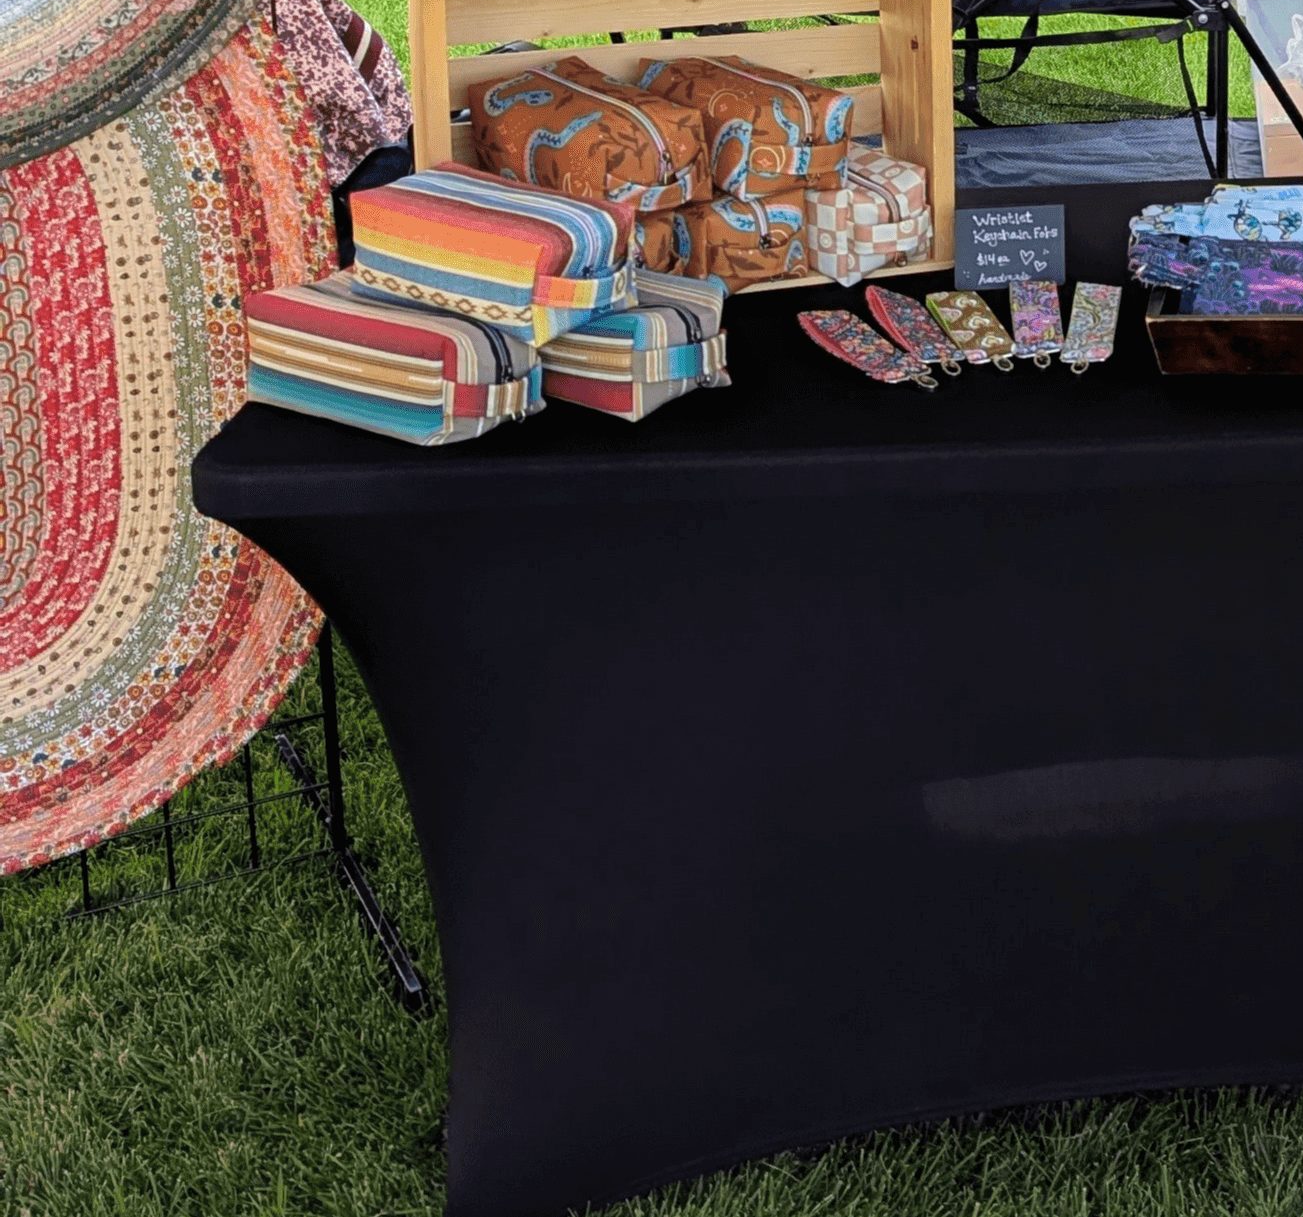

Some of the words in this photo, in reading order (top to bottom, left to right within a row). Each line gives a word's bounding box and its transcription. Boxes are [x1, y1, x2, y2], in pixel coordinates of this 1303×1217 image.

[972, 210, 1034, 227] Wristlet
[972, 228, 1032, 248] Keychain
[976, 252, 996, 266] $14
